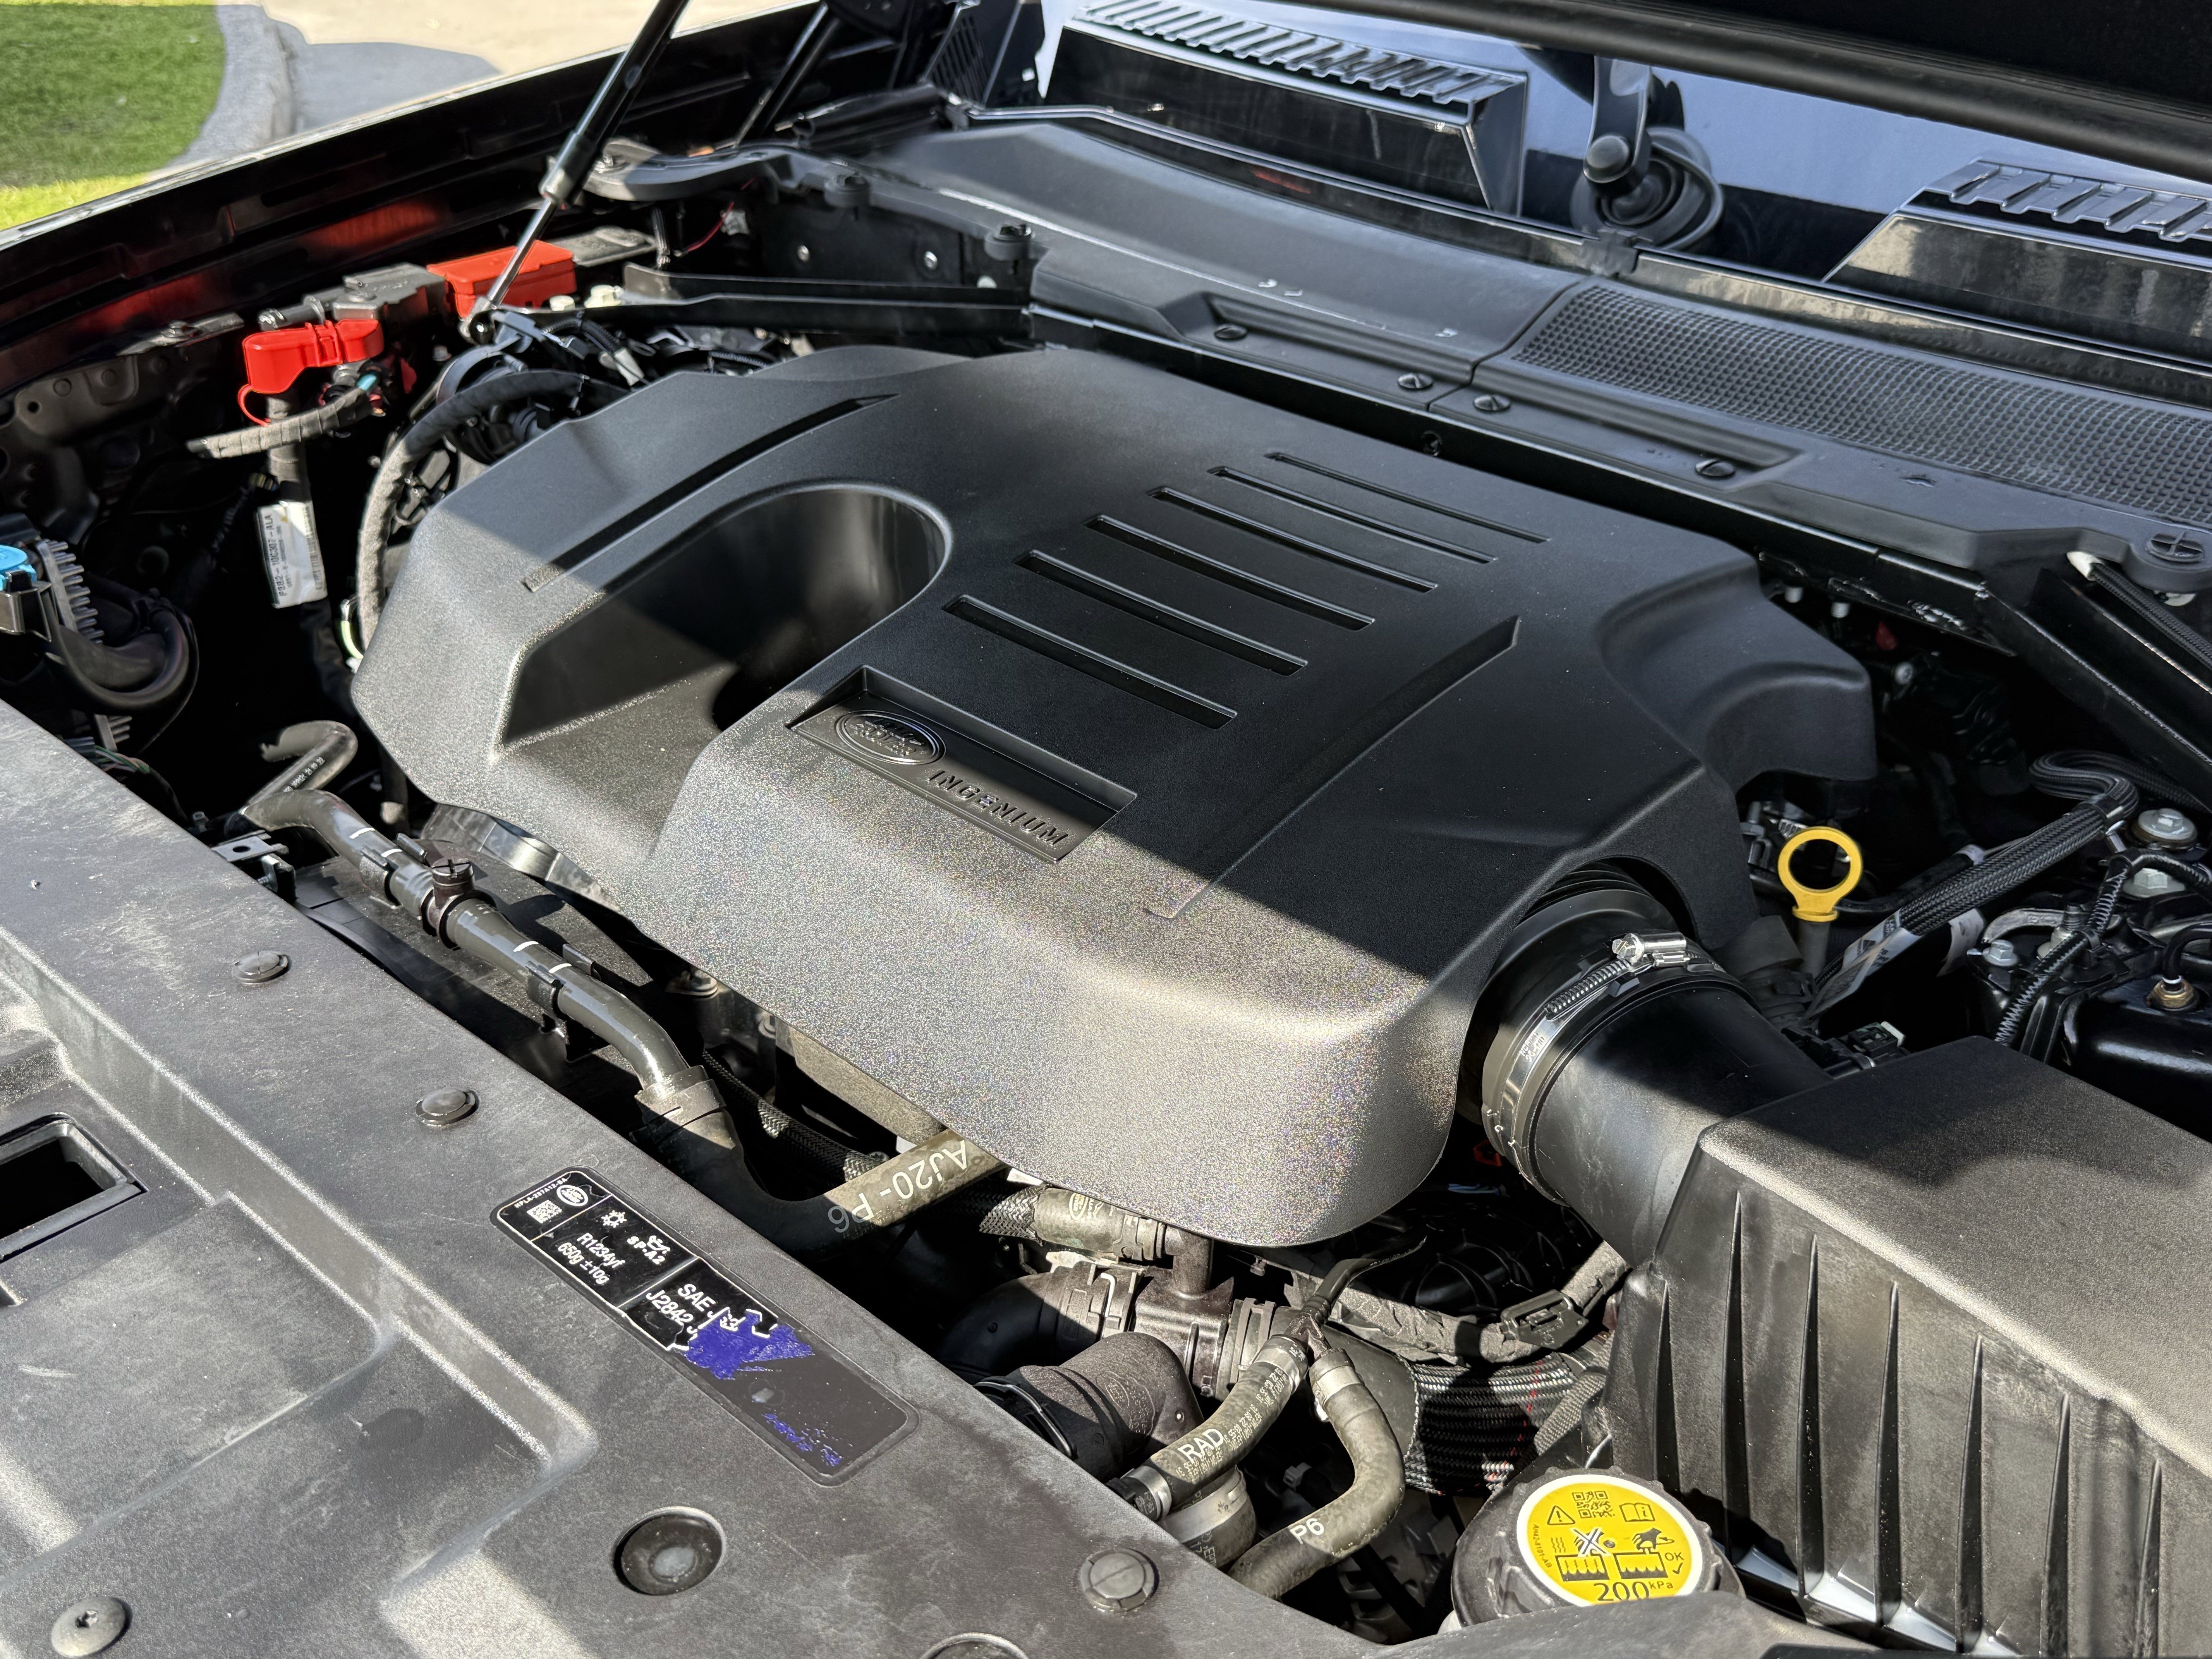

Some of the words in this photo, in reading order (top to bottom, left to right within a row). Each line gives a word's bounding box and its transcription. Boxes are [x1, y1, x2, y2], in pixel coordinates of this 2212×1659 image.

[928, 769, 1069, 845] INGENIUM
[827, 1196, 875, 1233] P6
[558, 1242, 584, 1264] 650g
[577, 1233, 625, 1268] R1234yf
[646, 1290, 694, 1326] J2842
[678, 1283, 716, 1312] SAE
[1178, 1428, 1224, 1464] RAD
[1290, 1518, 1324, 1545] P6
[1664, 1552, 1684, 1561] OK
[1593, 1581, 1650, 1601] 200
[1650, 1581, 1673, 1589] kPa
